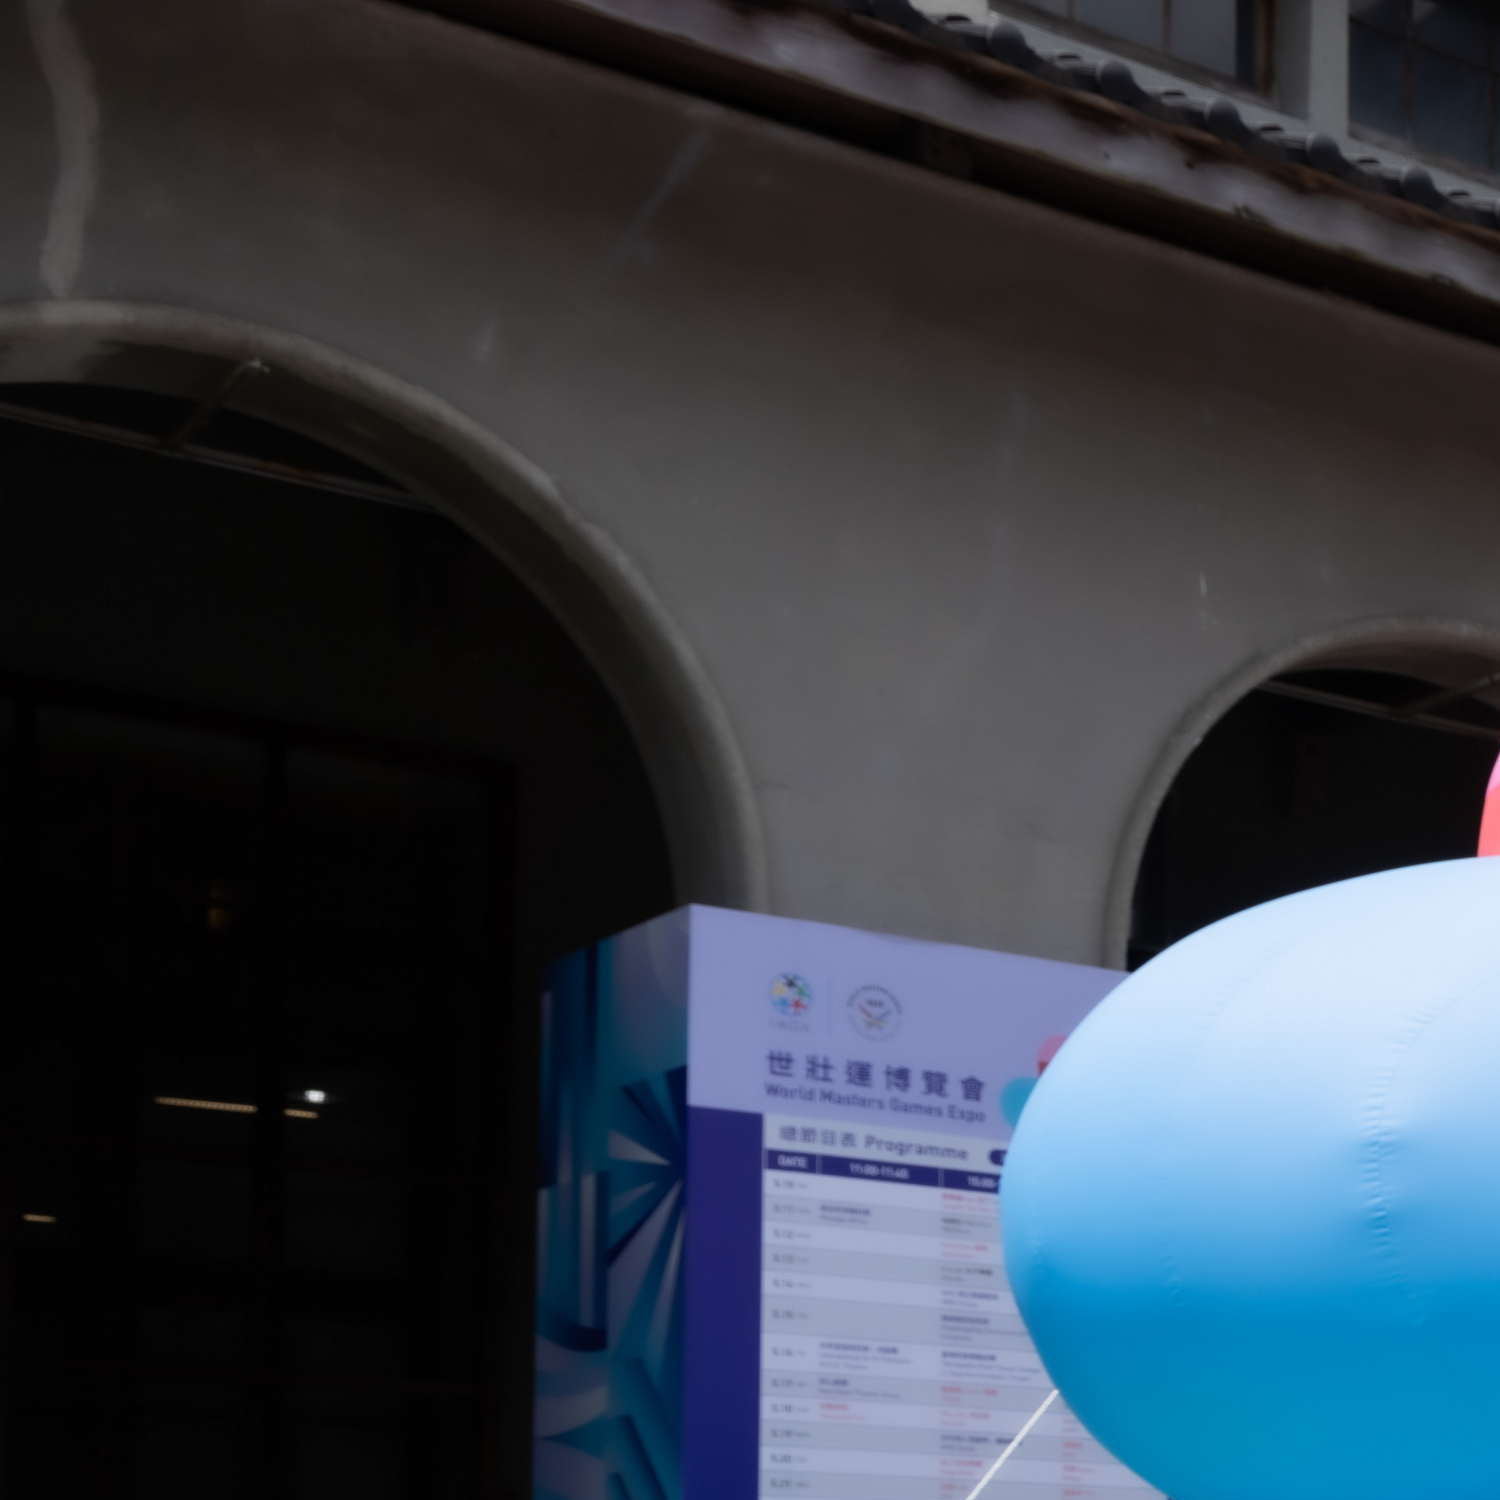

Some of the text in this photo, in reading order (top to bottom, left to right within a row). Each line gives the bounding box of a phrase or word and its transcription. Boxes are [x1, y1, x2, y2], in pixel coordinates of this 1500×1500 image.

[765, 1050, 985, 1102] 世壯運博覽會
[765, 1082, 987, 1123] World Masters Games Expo
[864, 1134, 969, 1160] Programme
